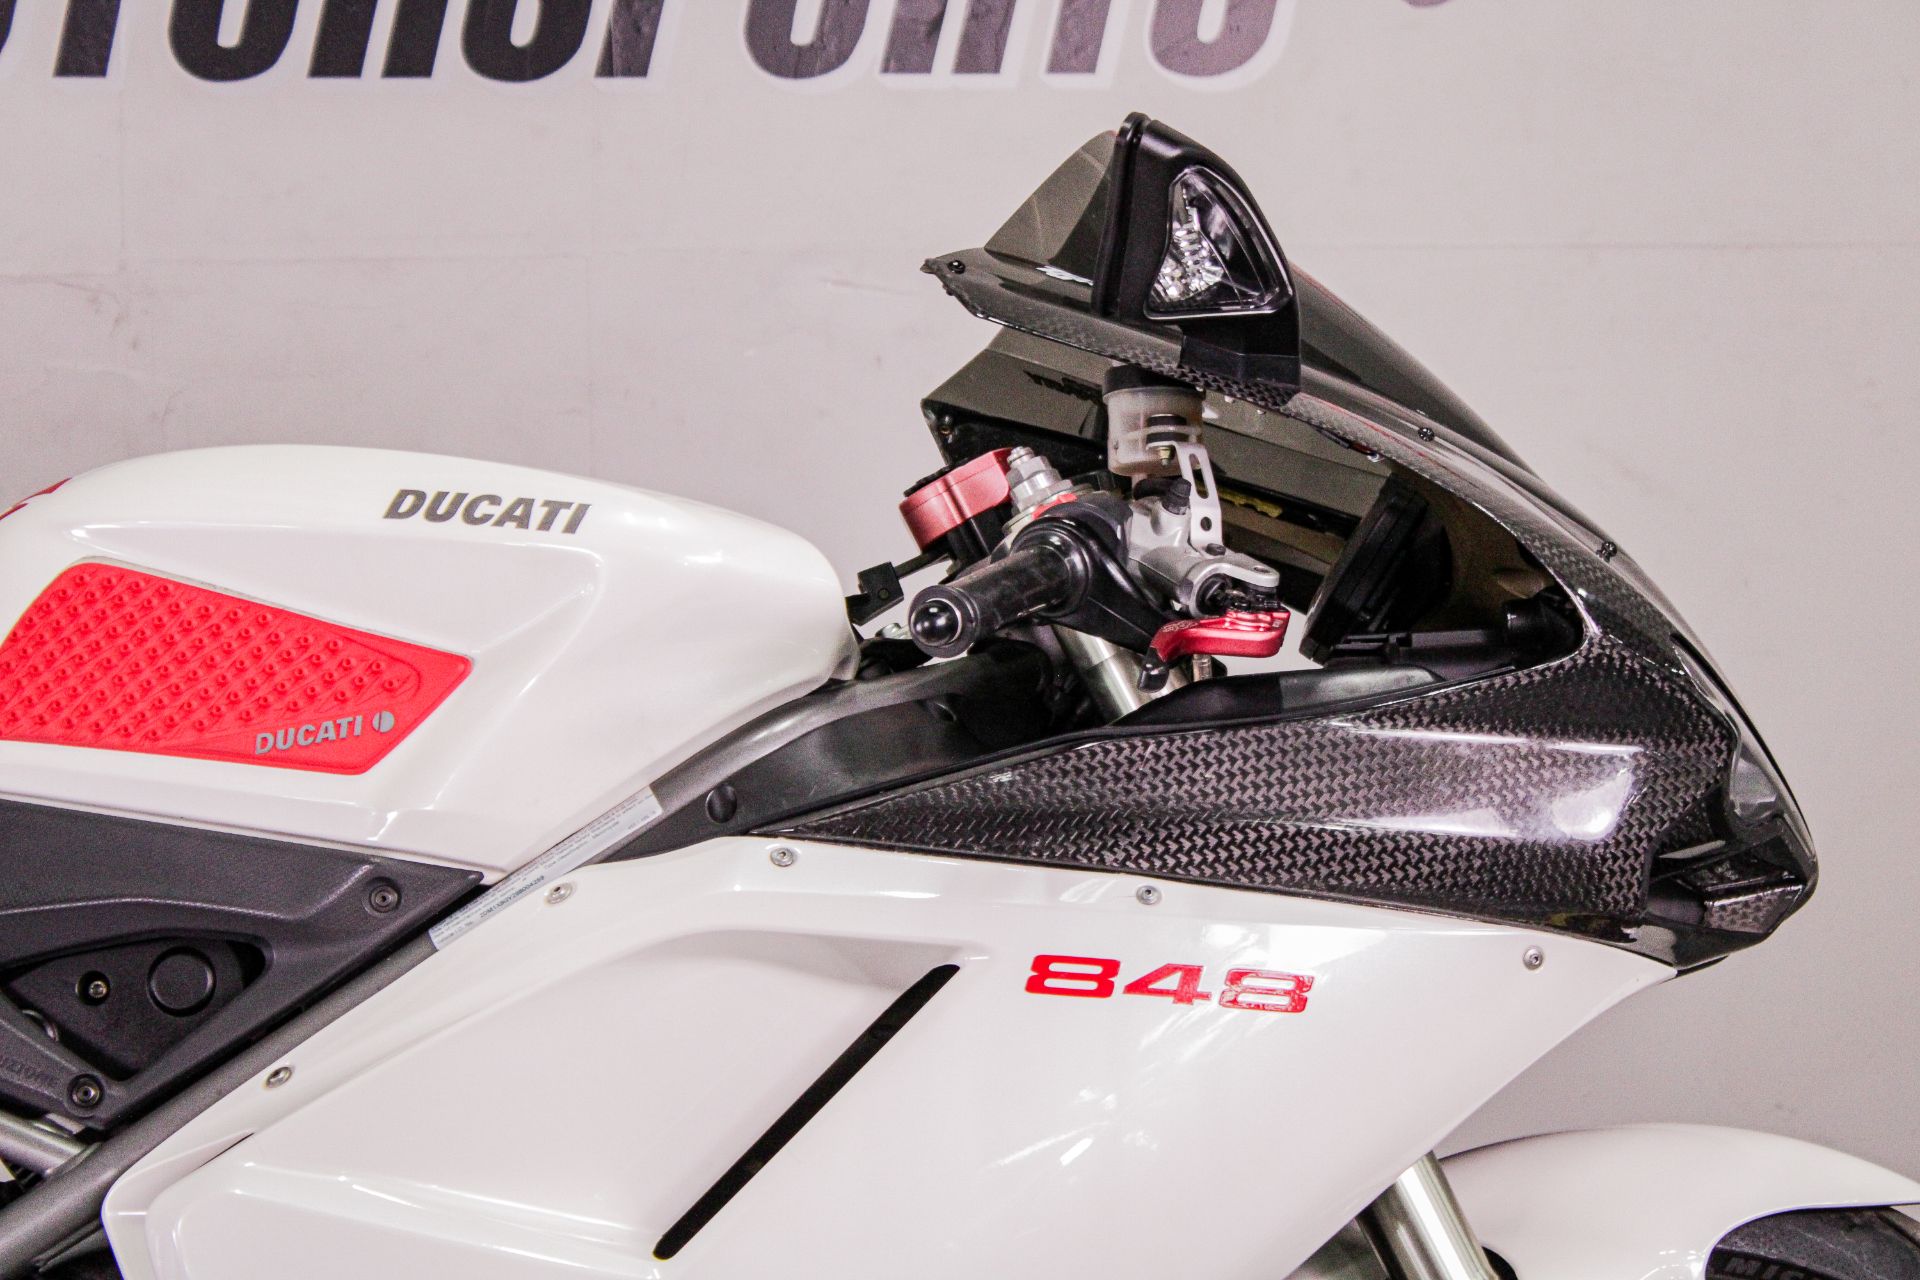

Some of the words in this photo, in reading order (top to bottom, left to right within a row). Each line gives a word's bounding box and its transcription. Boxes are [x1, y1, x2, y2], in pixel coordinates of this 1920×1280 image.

[383, 489, 592, 534] DUCATI
[255, 715, 363, 755] DUCATI
[1024, 954, 1315, 1013] 848
